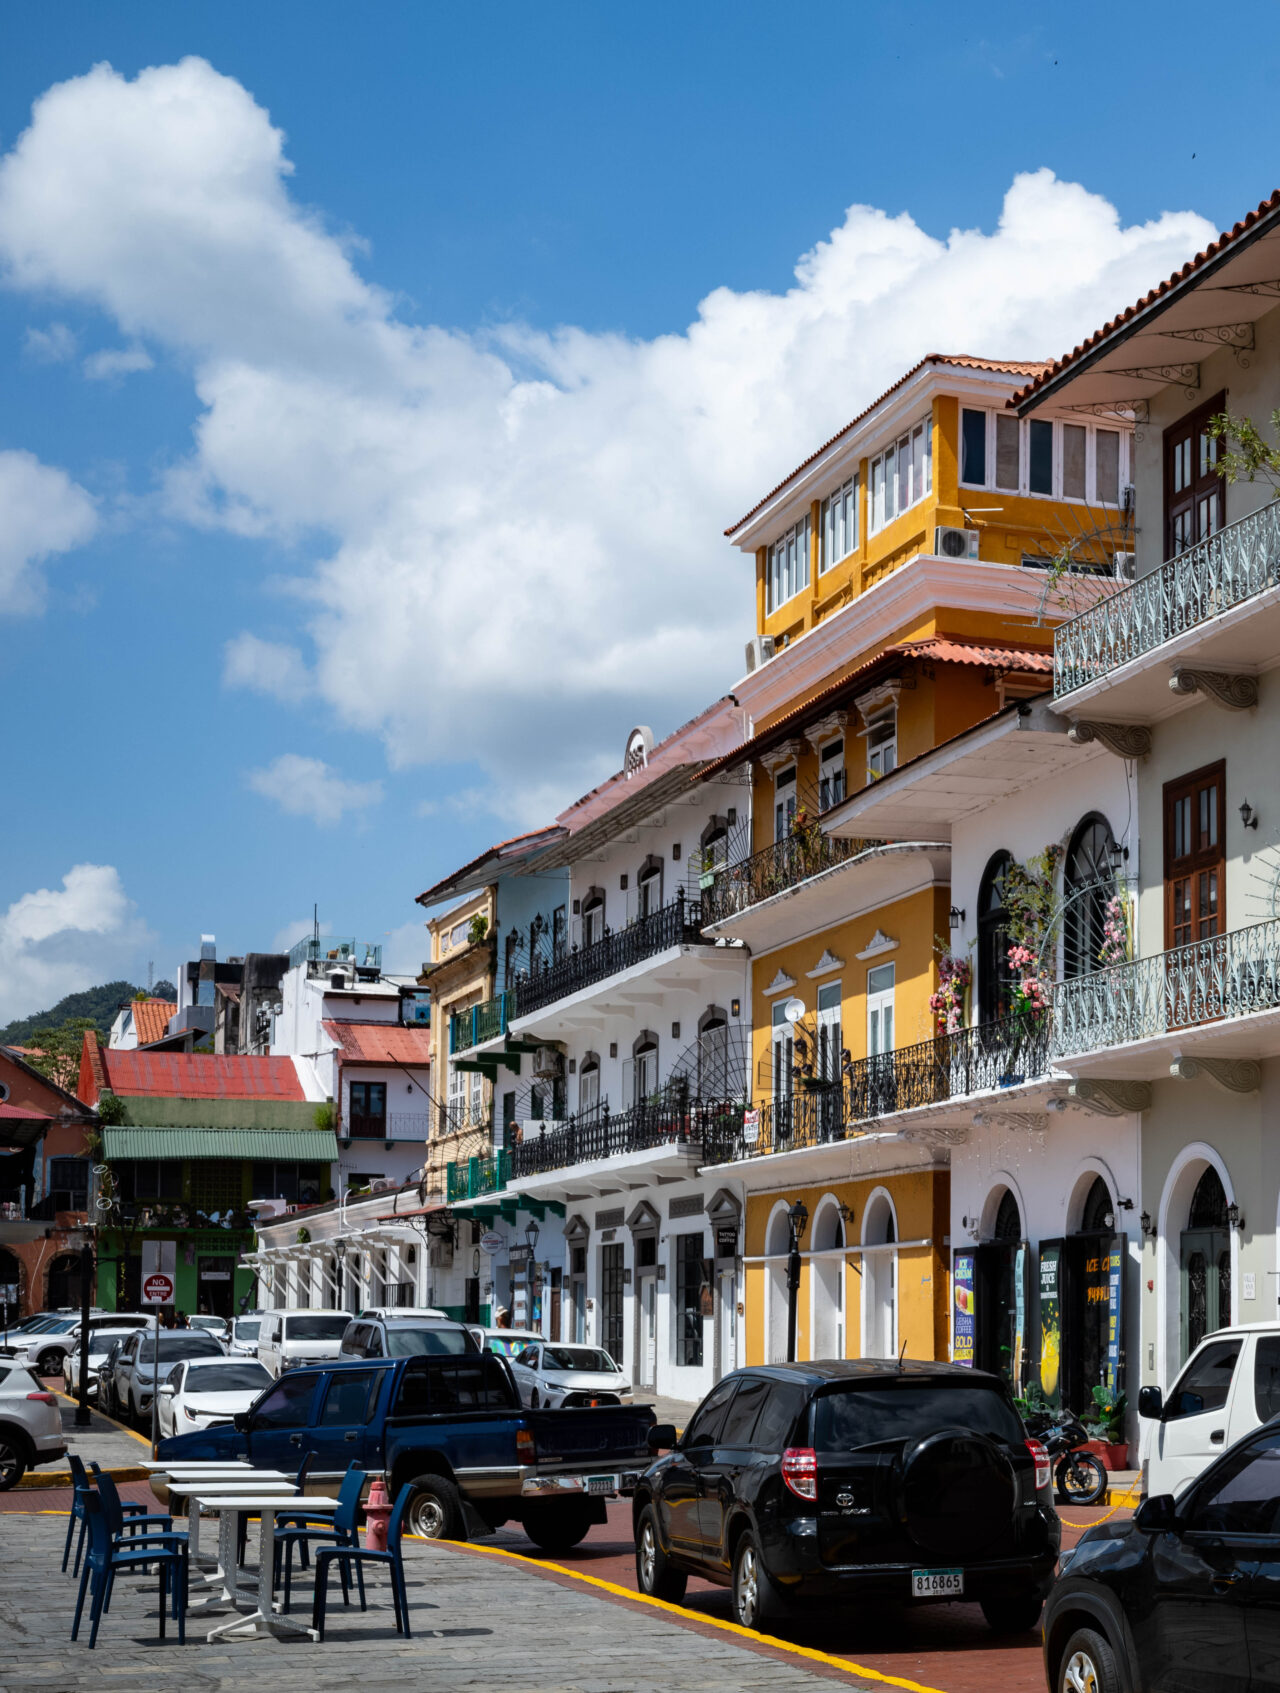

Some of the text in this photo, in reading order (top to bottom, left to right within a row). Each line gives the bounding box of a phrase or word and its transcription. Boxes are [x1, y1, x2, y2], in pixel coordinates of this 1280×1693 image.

[1040, 1260, 1057, 1272] FRESH
[1086, 1258, 1099, 1272] ICE
[1041, 1272, 1055, 1285] JUICE
[956, 1325, 972, 1334] COFFEE
[955, 1336, 972, 1348] GOLD
[917, 1575, 960, 1590] 816865
